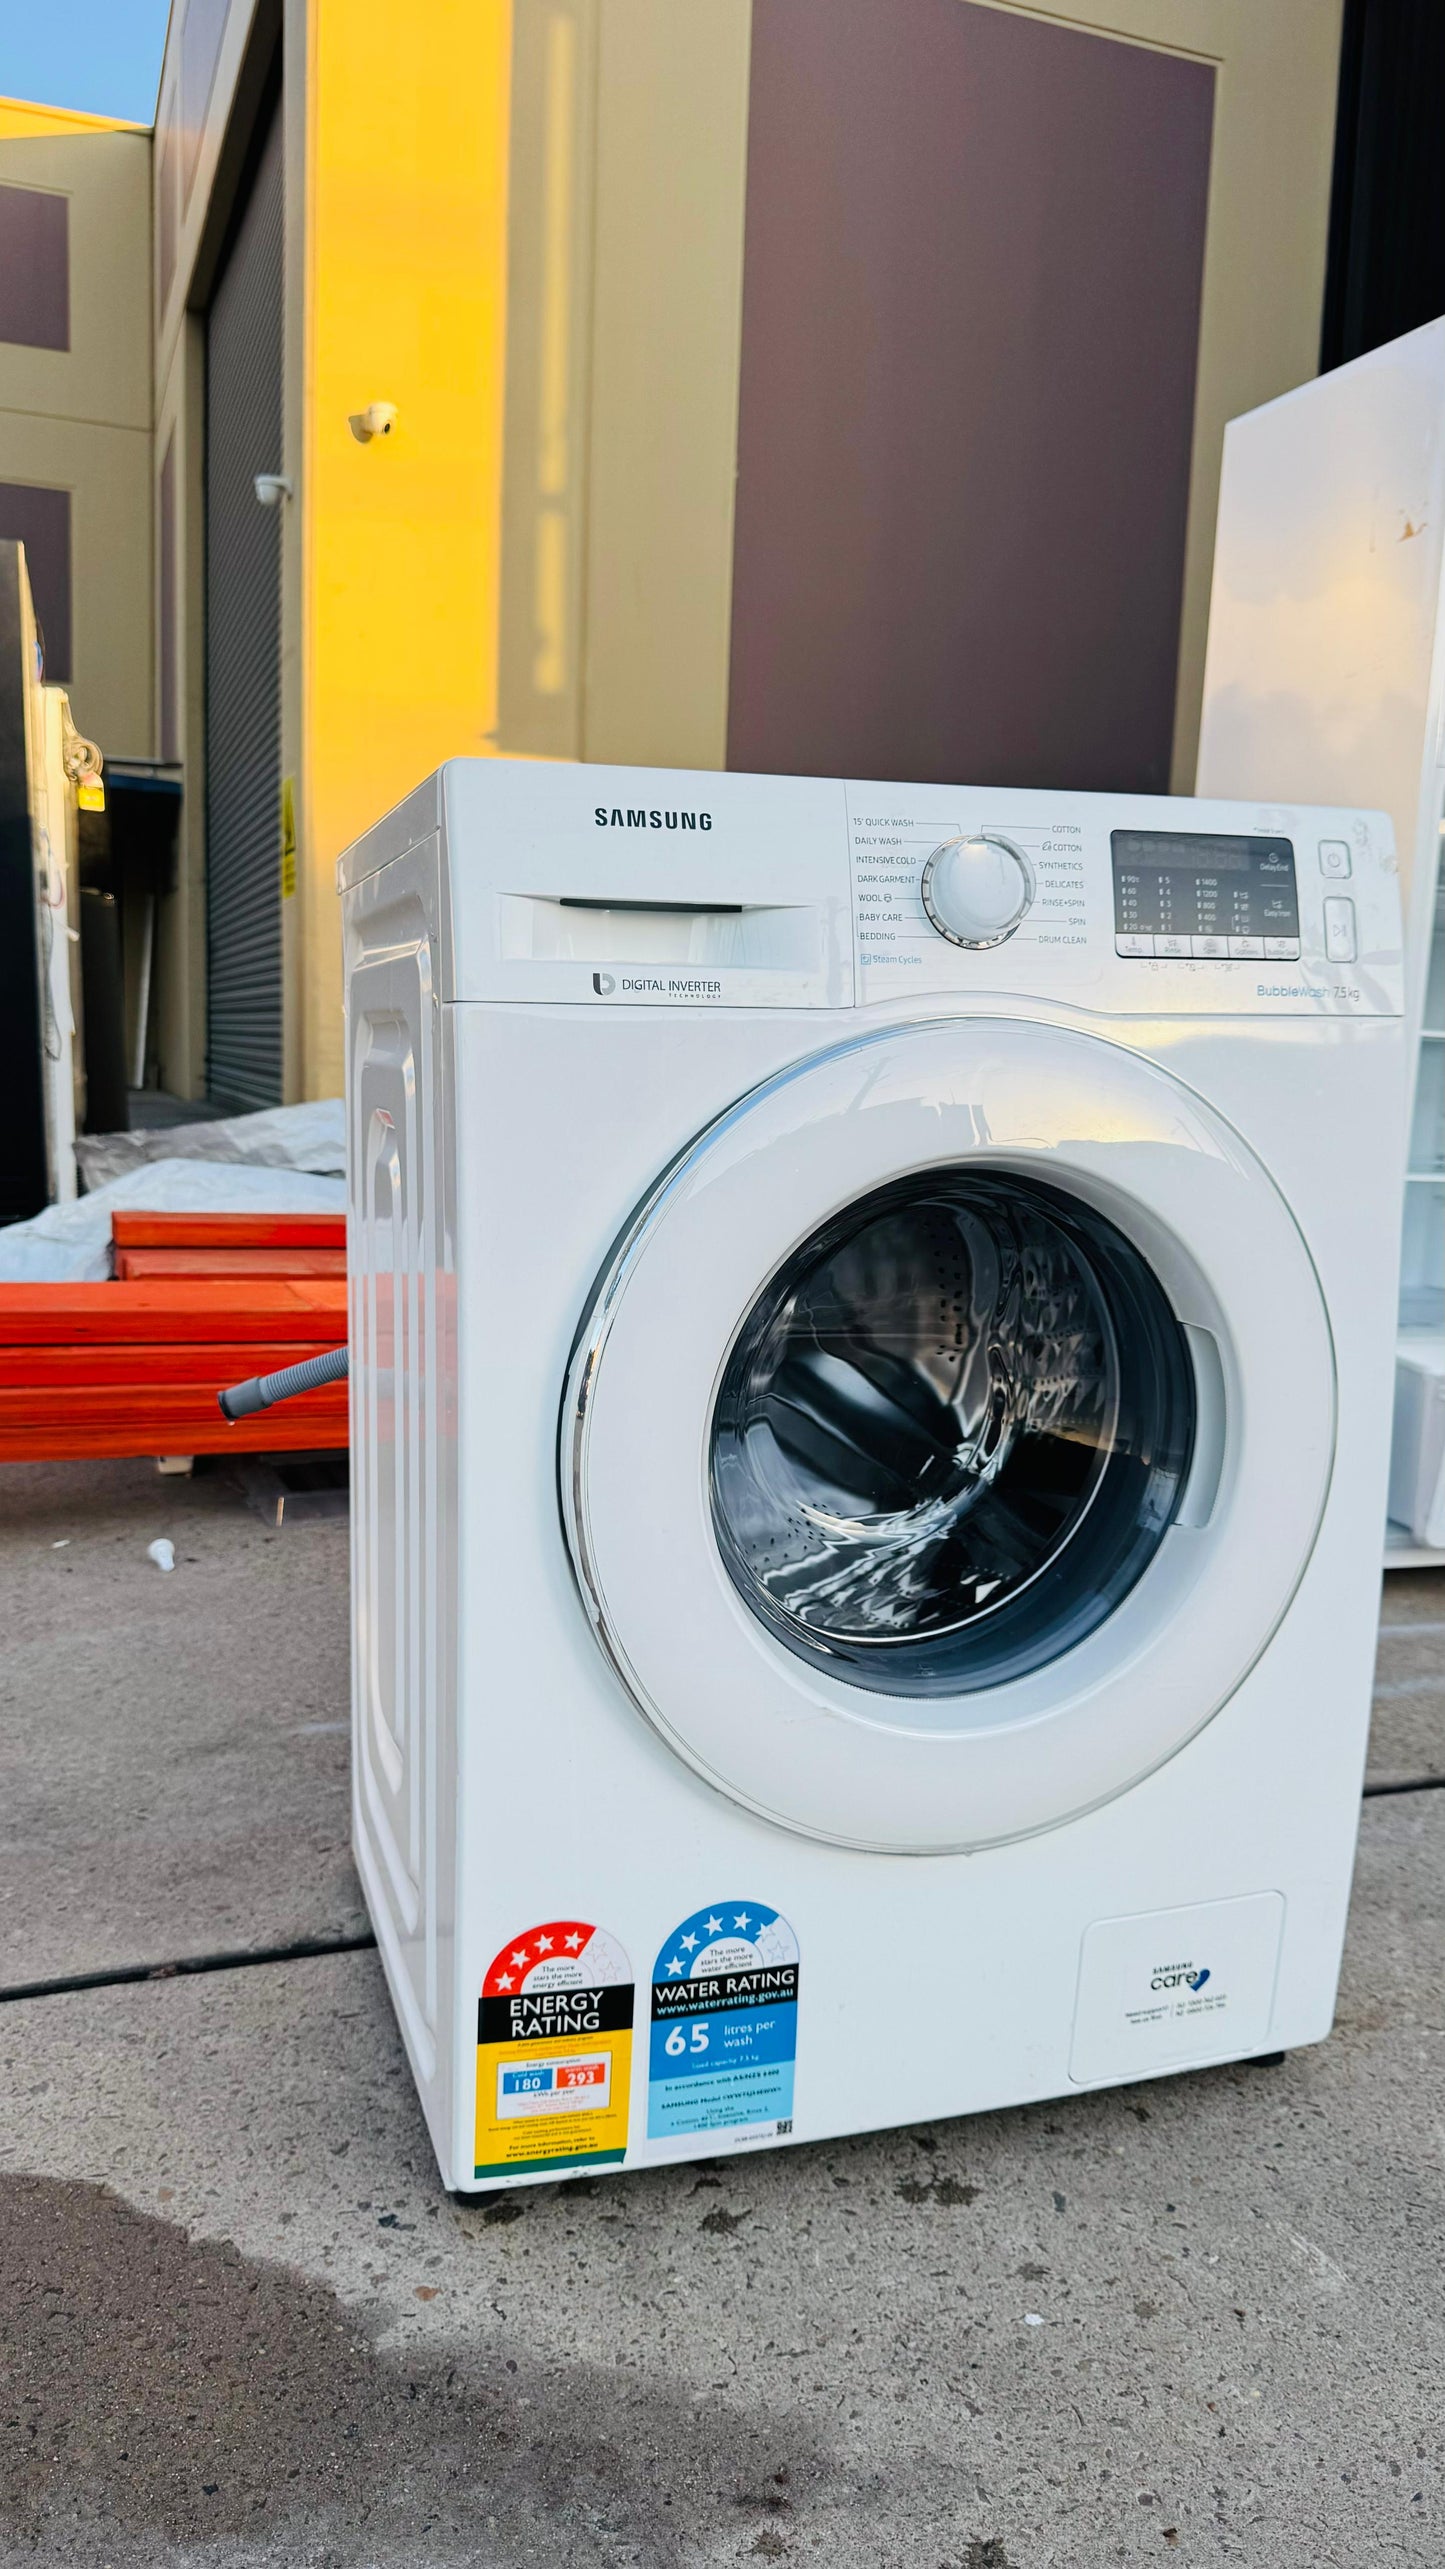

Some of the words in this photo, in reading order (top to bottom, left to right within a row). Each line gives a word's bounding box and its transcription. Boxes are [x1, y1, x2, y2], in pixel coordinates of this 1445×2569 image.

[595, 808, 712, 830] SAMSUNG
[865, 818, 890, 827] QUICK
[891, 819, 914, 827] WASH
[1052, 825, 1081, 834] COTTON
[855, 837, 877, 845] DAILY
[878, 837, 902, 845] WASH
[1053, 843, 1082, 852] COTTON
[856, 856, 895, 864] INTENSIVE
[896, 856, 916, 865] COLD
[1039, 862, 1083, 870] SYNTHETICS
[857, 875, 878, 883] DARK
[879, 875, 915, 884] GARMENT
[1045, 880, 1084, 889] DELICATES
[858, 894, 882, 902] WOOL
[859, 913, 880, 921] BABY
[1068, 918, 1086, 926] SPIN
[860, 932, 896, 940] BEDDING
[1039, 936, 1061, 944] DRUM
[1062, 936, 1087, 944] CLEAN
[872, 955, 897, 964] Steam
[898, 955, 922, 965] Cycles
[622, 979, 665, 991] DIGITAL
[669, 980, 721, 992] INVERTER
[1257, 985, 1329, 998] BubbleWash
[709, 1949, 724, 1957] The
[726, 1947, 745, 1955] more
[701, 1958, 718, 1966] stars
[720, 1956, 732, 1964] the
[734, 1953, 753, 1961] more
[701, 1966, 721, 1974] water
[724, 1960, 752, 1971] efficient
[564, 1971, 583, 1979] more
[532, 1980, 555, 1989] energy
[556, 1978, 583, 1987] efficient
[1150, 1970, 1198, 1991] care
[655, 1980, 720, 2003] WATER
[726, 1969, 795, 1994] RATING
[510, 1991, 604, 2018] ENERGY
[657, 1988, 794, 2015] www.waterrating.gov.au
[512, 2011, 600, 2038] RATING
[724, 2024, 752, 2036] litres
[756, 2020, 776, 2034] per
[665, 2022, 709, 2057] 65
[723, 2035, 753, 2048] wash
[567, 2070, 595, 2087] 293
[514, 2077, 541, 2092] 180
